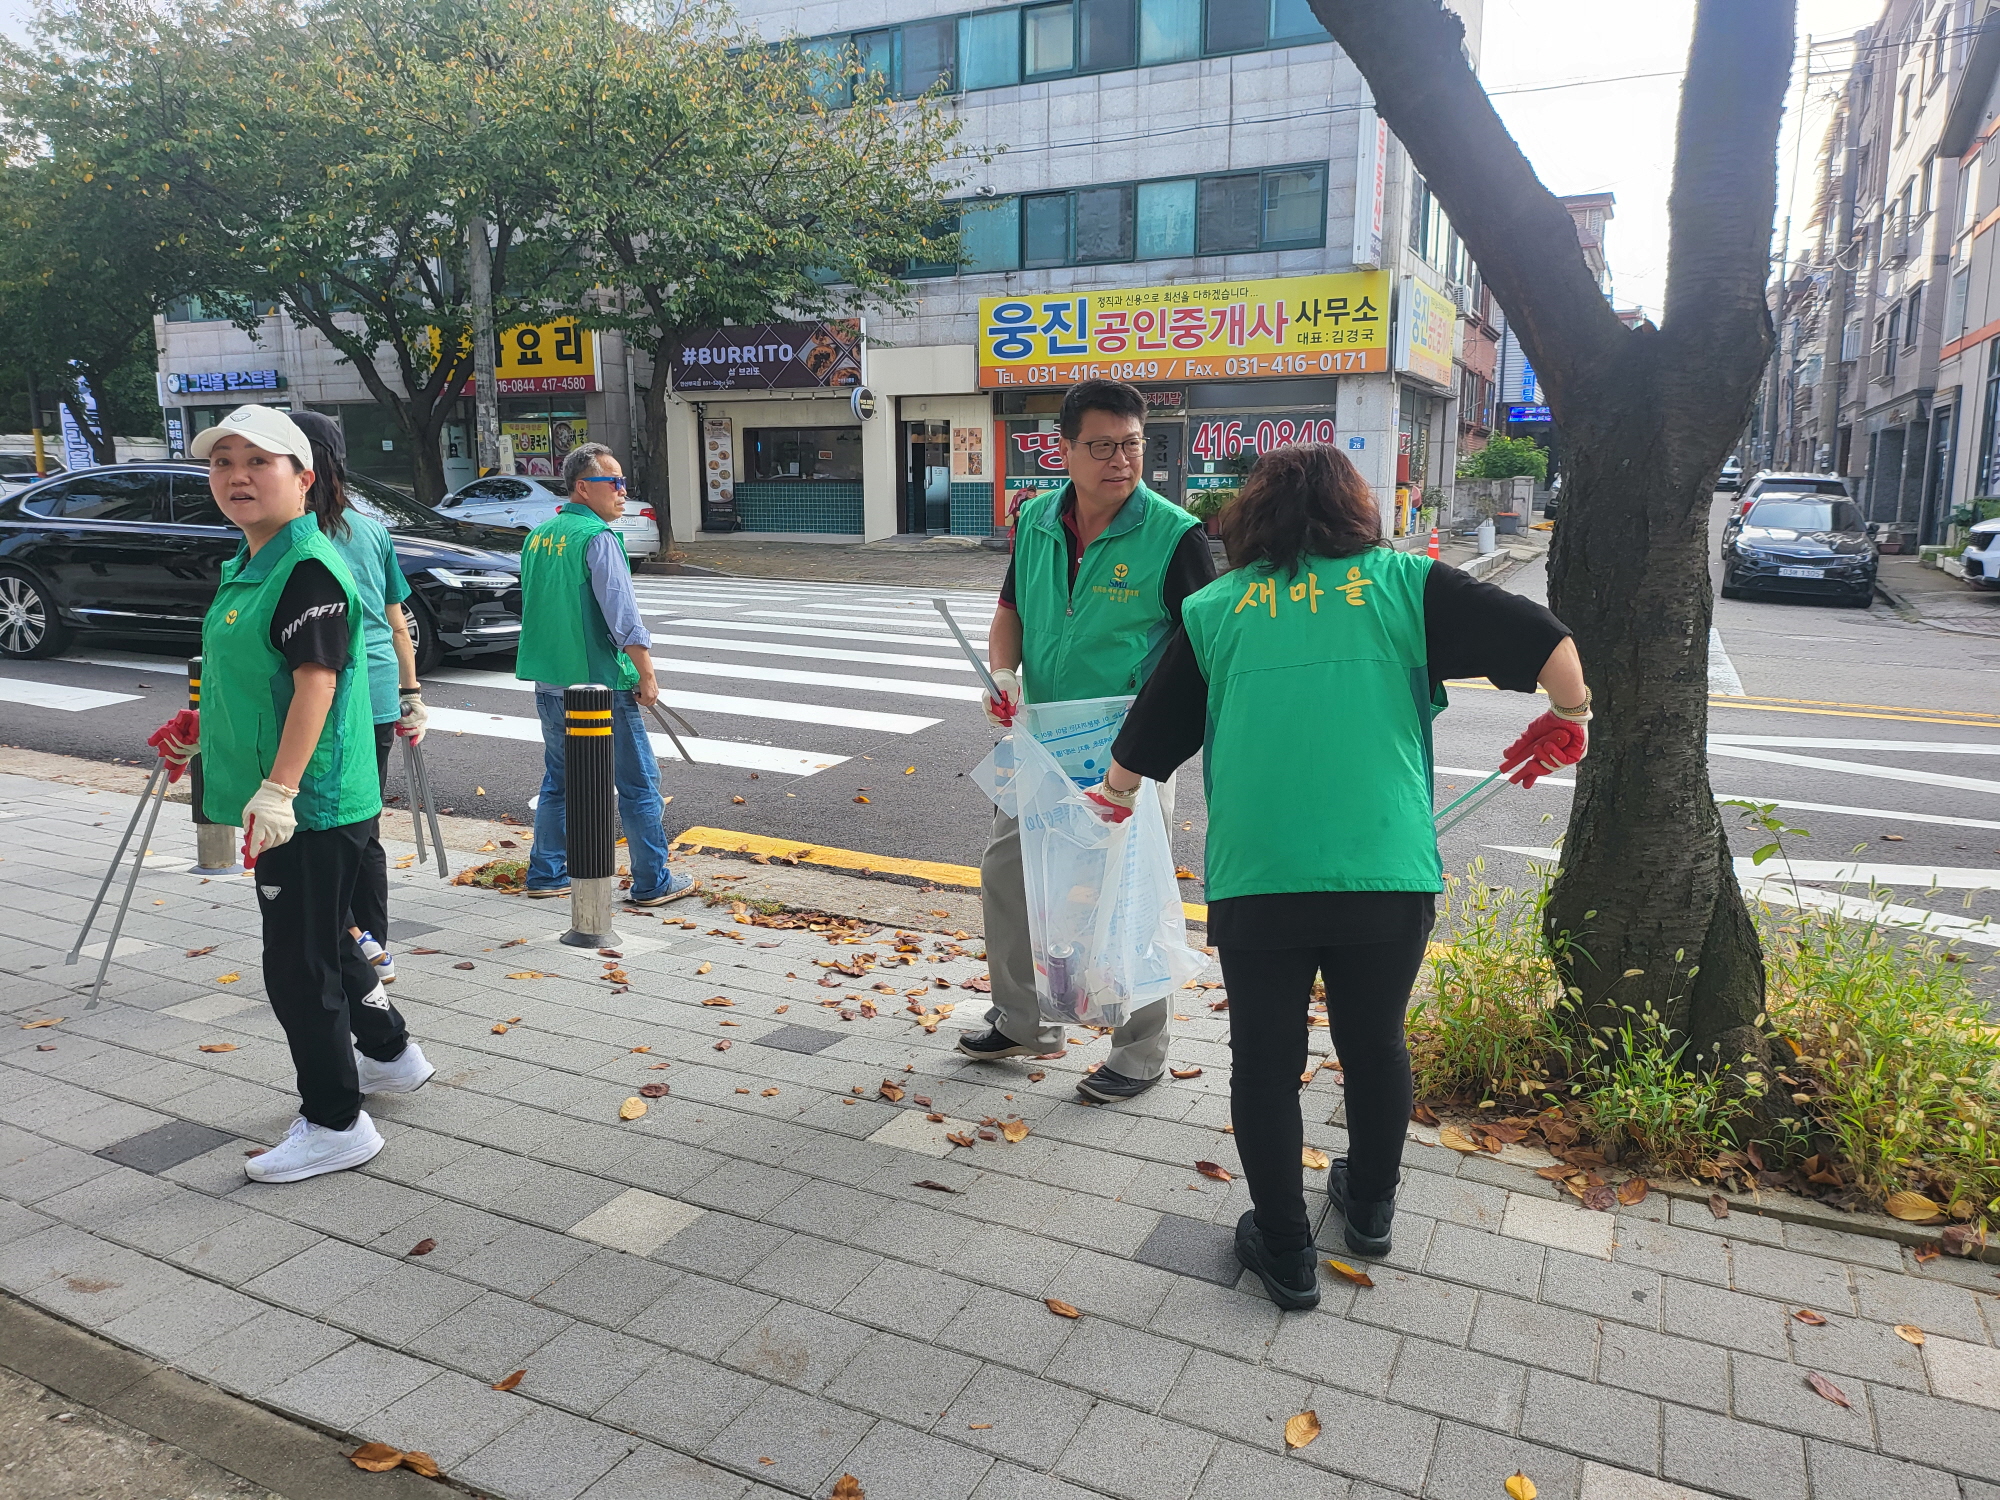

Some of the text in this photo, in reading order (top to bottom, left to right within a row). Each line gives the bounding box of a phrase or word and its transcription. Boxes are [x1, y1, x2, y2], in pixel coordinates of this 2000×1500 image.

[1097, 296, 1123, 309] 정직과
[1125, 293, 1159, 306] 신용으로
[1163, 291, 1190, 303] 최선을
[988, 297, 1089, 360] 웅진
[1093, 301, 1289, 353] 공인중개사
[1294, 296, 1379, 327] 사무소
[682, 344, 793, 366] #BURRITO
[1028, 361, 1159, 383] 031-416-0849
[1225, 351, 1367, 375] 031-416-0171
[188, 372, 225, 393] 그린홀
[226, 370, 278, 391] 로스트볼
[542, 376, 586, 390] 417-4580
[1196, 478, 1233, 488] 부동산
[1234, 566, 1374, 618] 새마을
